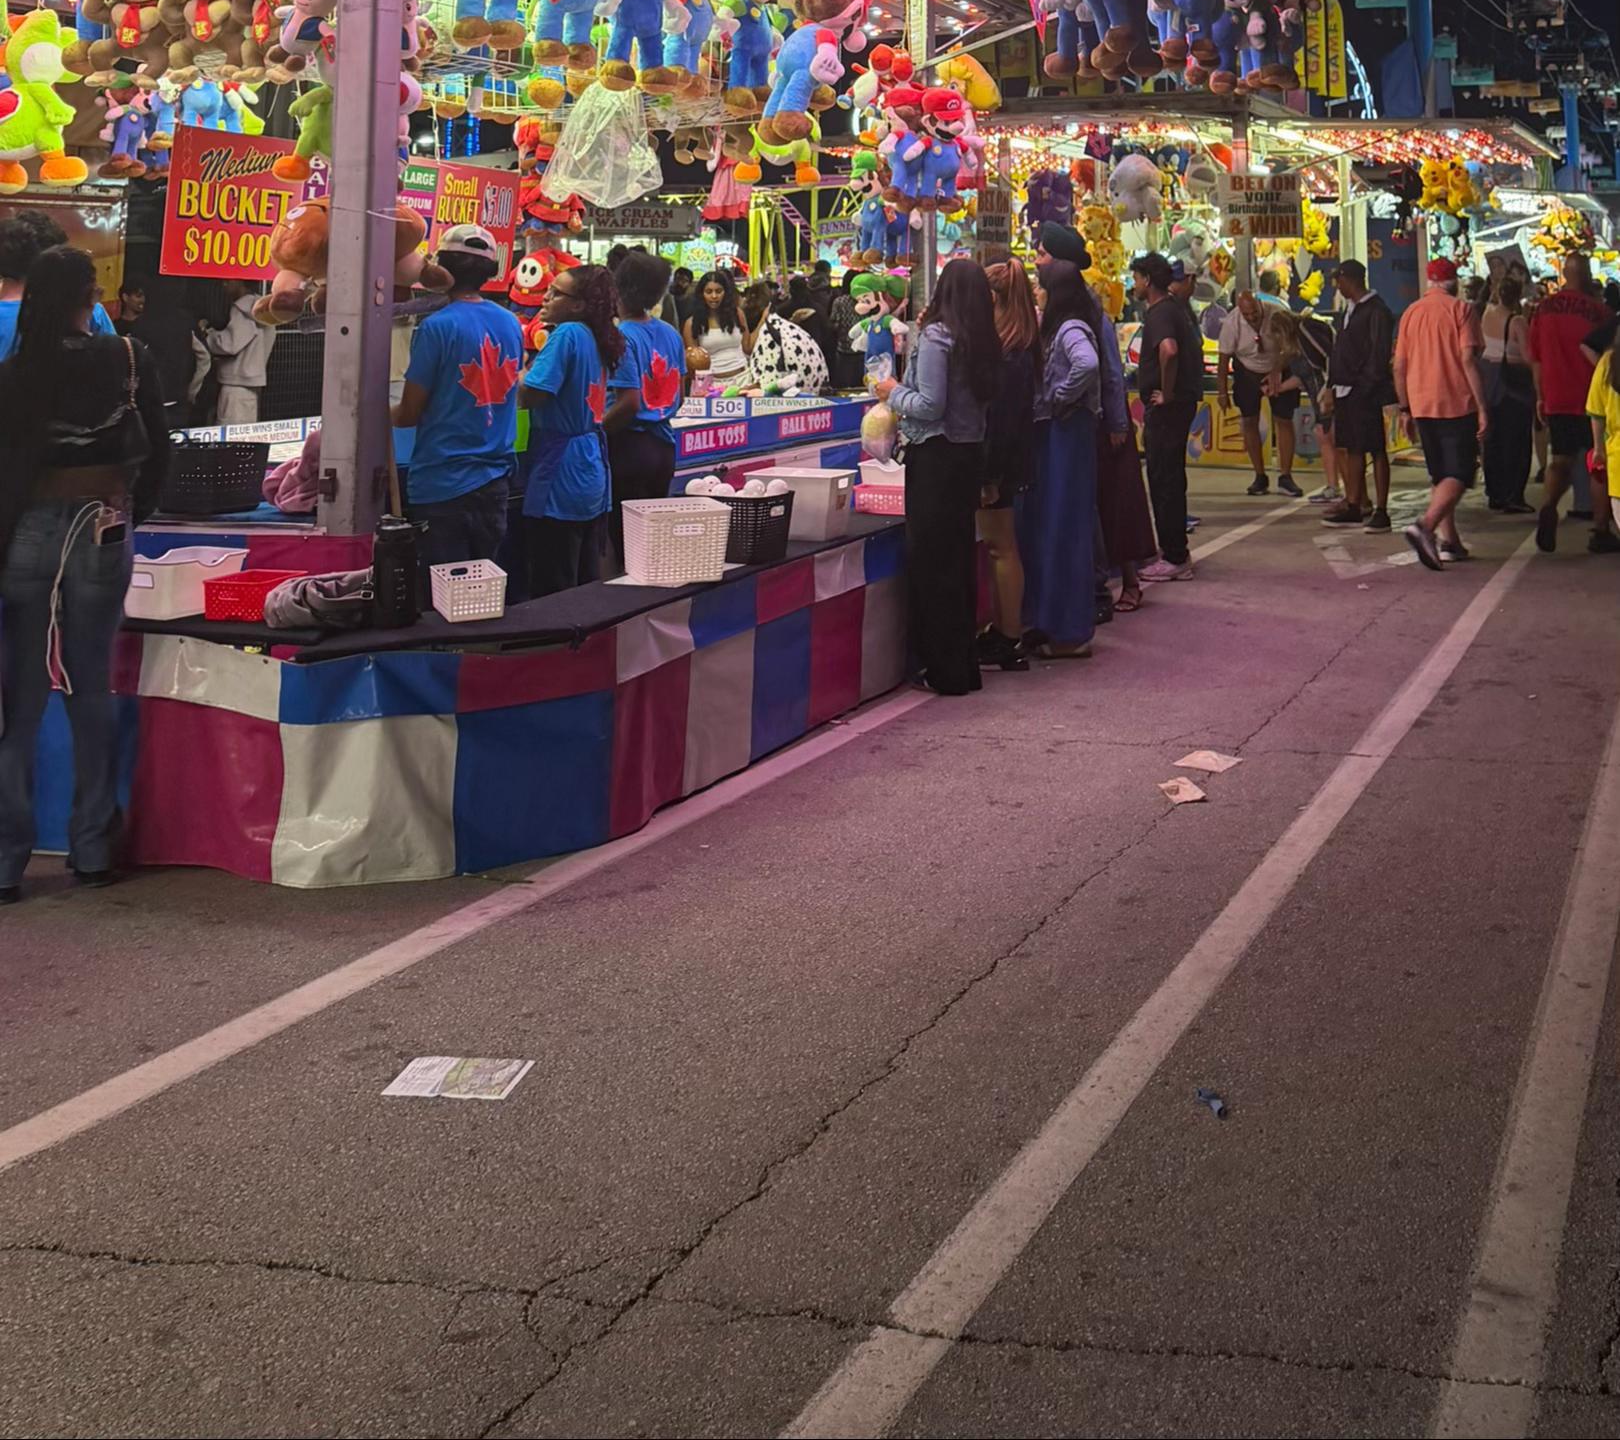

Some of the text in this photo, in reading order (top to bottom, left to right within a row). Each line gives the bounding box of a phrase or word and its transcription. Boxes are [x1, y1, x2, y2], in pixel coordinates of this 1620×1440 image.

[1306, 10, 1321, 75] GAME
[403, 170, 437, 187] LARGE
[444, 172, 479, 197] Small
[1229, 175, 1296, 192] BET ON
[177, 178, 294, 227] BUCKET
[396, 196, 433, 211] EDIUM
[435, 195, 481, 225] BUCKET
[481, 181, 514, 228] $5.00
[588, 207, 674, 219] ICE CREAM
[1228, 218, 1245, 236] &
[183, 225, 272, 269] $10.00
[754, 398, 784, 407] GREEN
[785, 398, 807, 407] WINS
[228, 419, 299, 436] BLUE WINS SMALL
[780, 410, 832, 436] BALL TOSS
[684, 424, 746, 452] BALL TOSS
